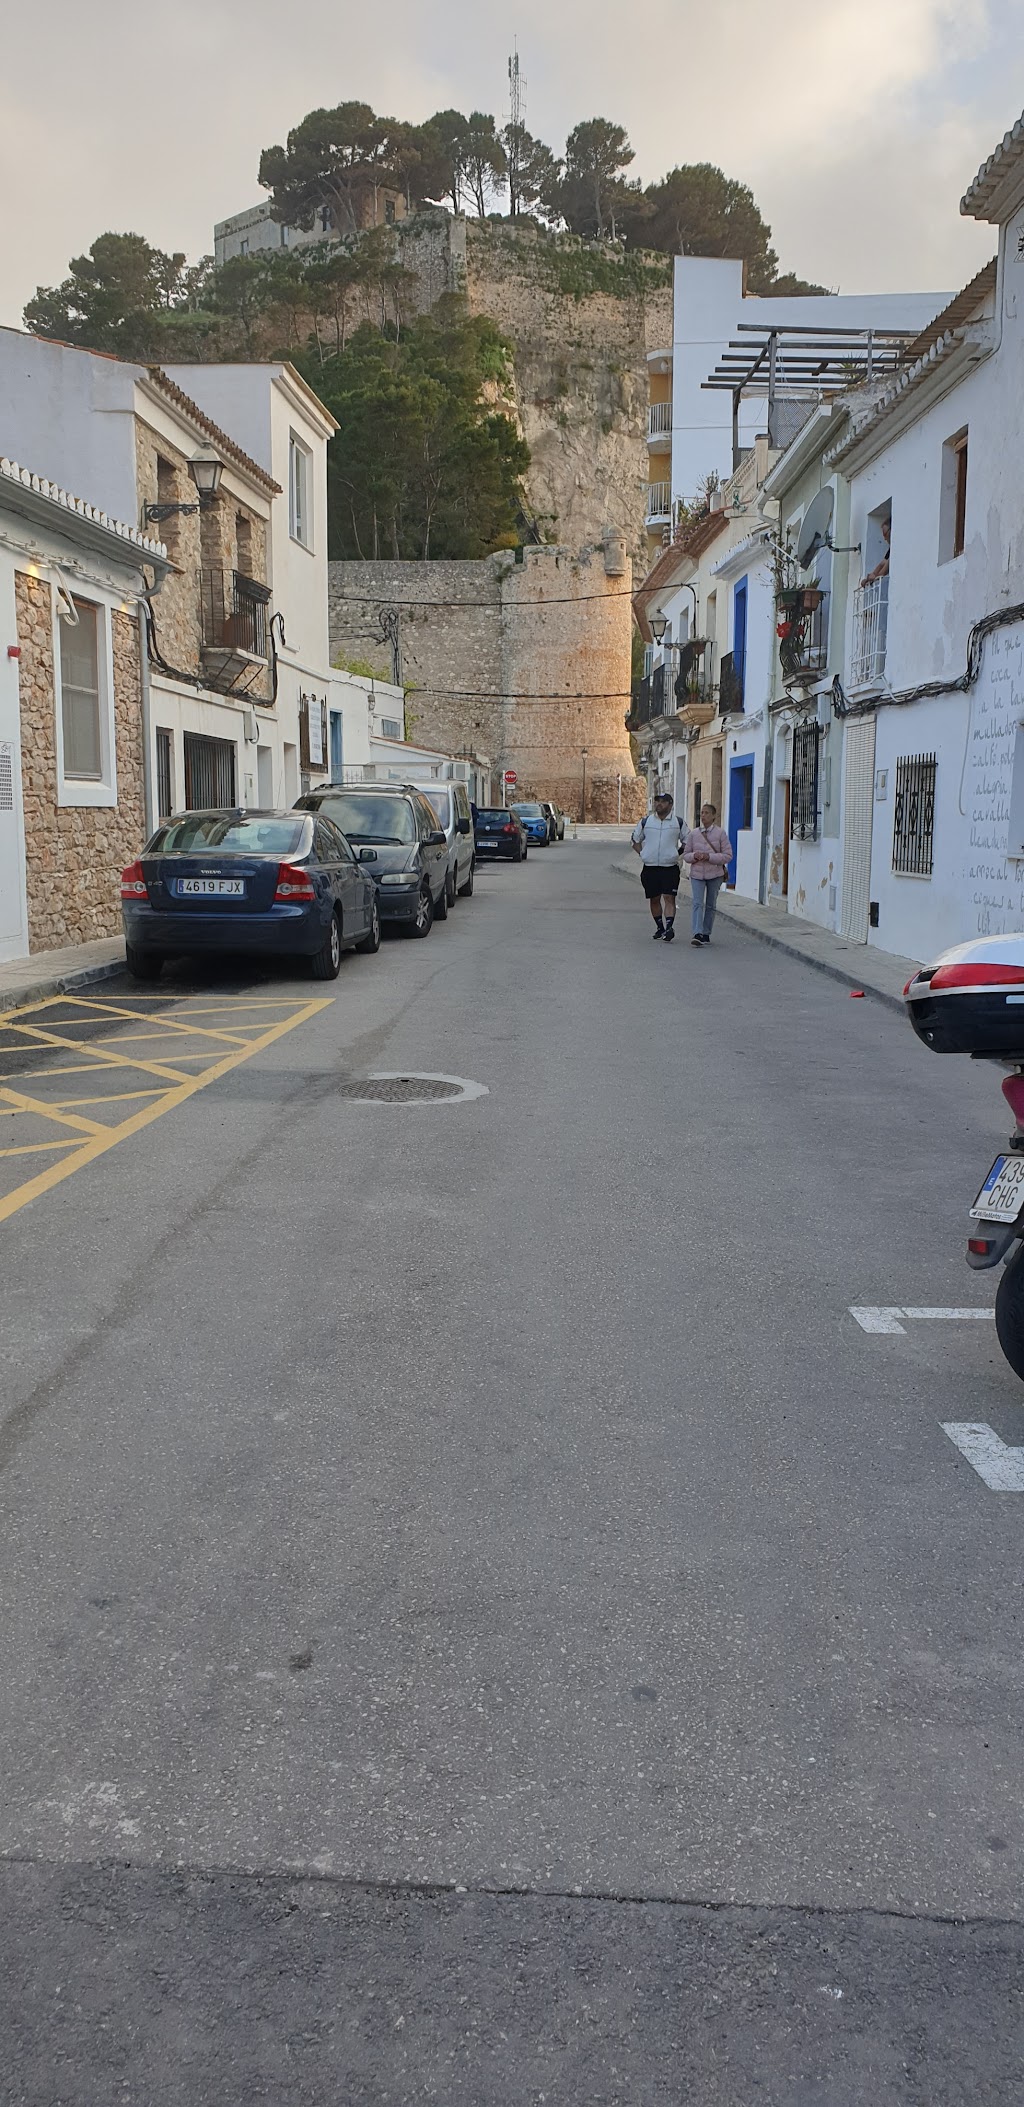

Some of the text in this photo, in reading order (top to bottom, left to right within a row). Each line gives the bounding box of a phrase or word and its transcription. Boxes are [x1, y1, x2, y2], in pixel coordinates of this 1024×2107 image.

[186, 881, 241, 893] 4619 FJX
[987, 1184, 1019, 1208] CHG
